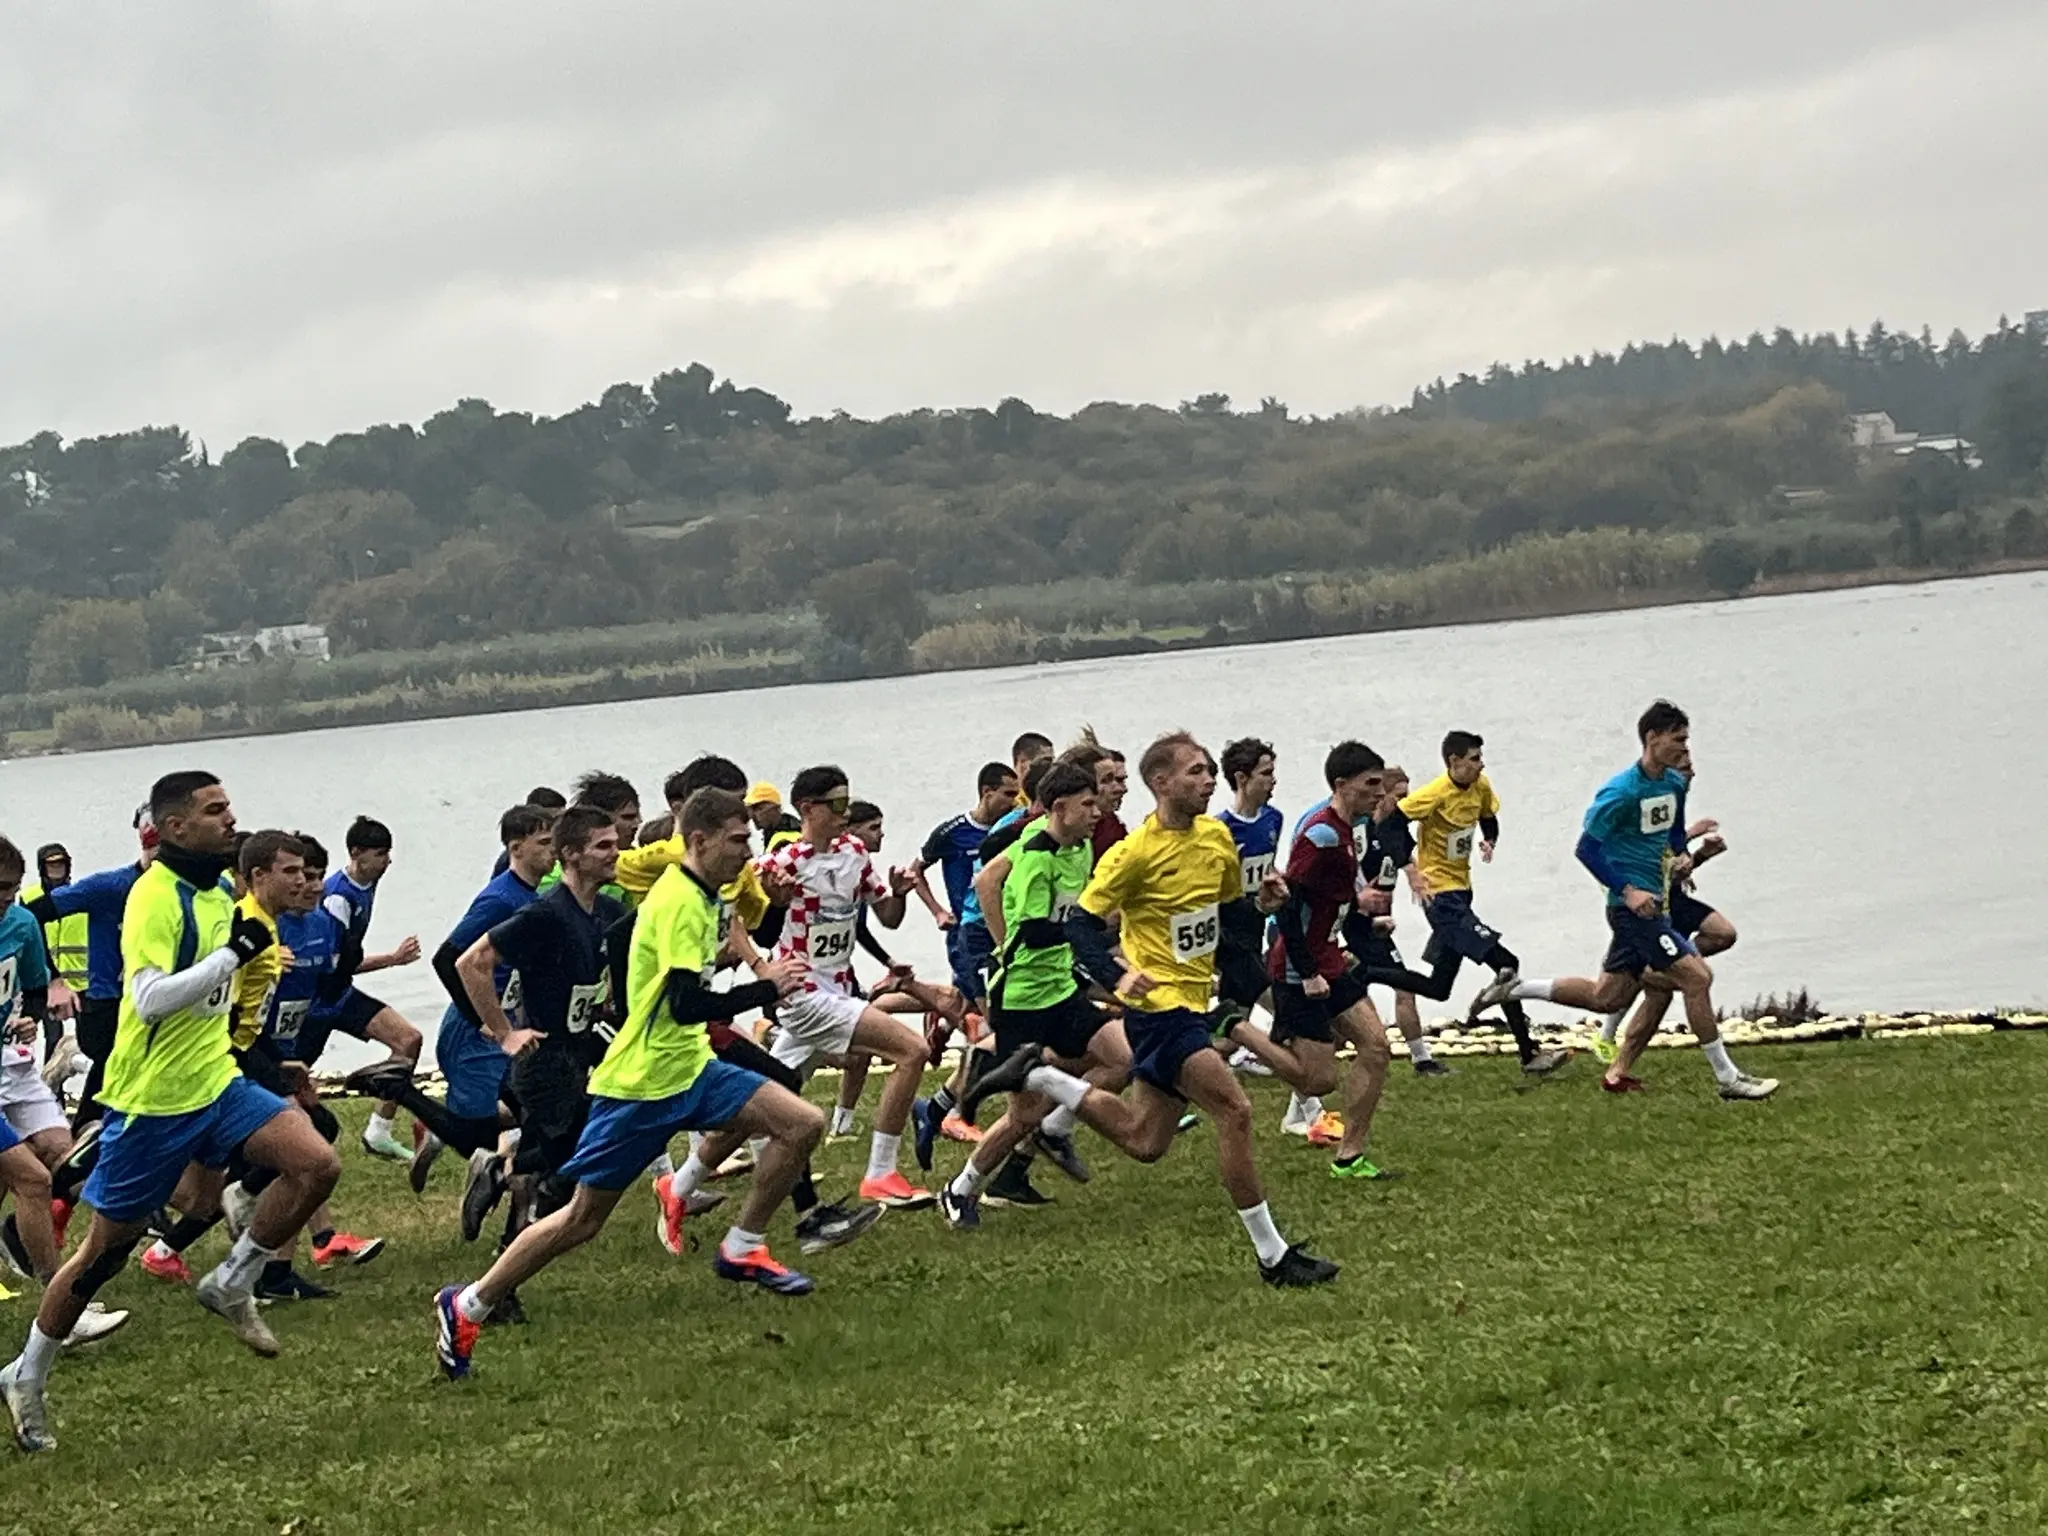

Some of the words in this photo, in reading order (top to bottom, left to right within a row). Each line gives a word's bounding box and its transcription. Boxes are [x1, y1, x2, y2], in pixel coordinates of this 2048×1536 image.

[813, 929, 850, 958] 294
[1178, 917, 1216, 951] 596
[1659, 934, 1678, 956] 9
